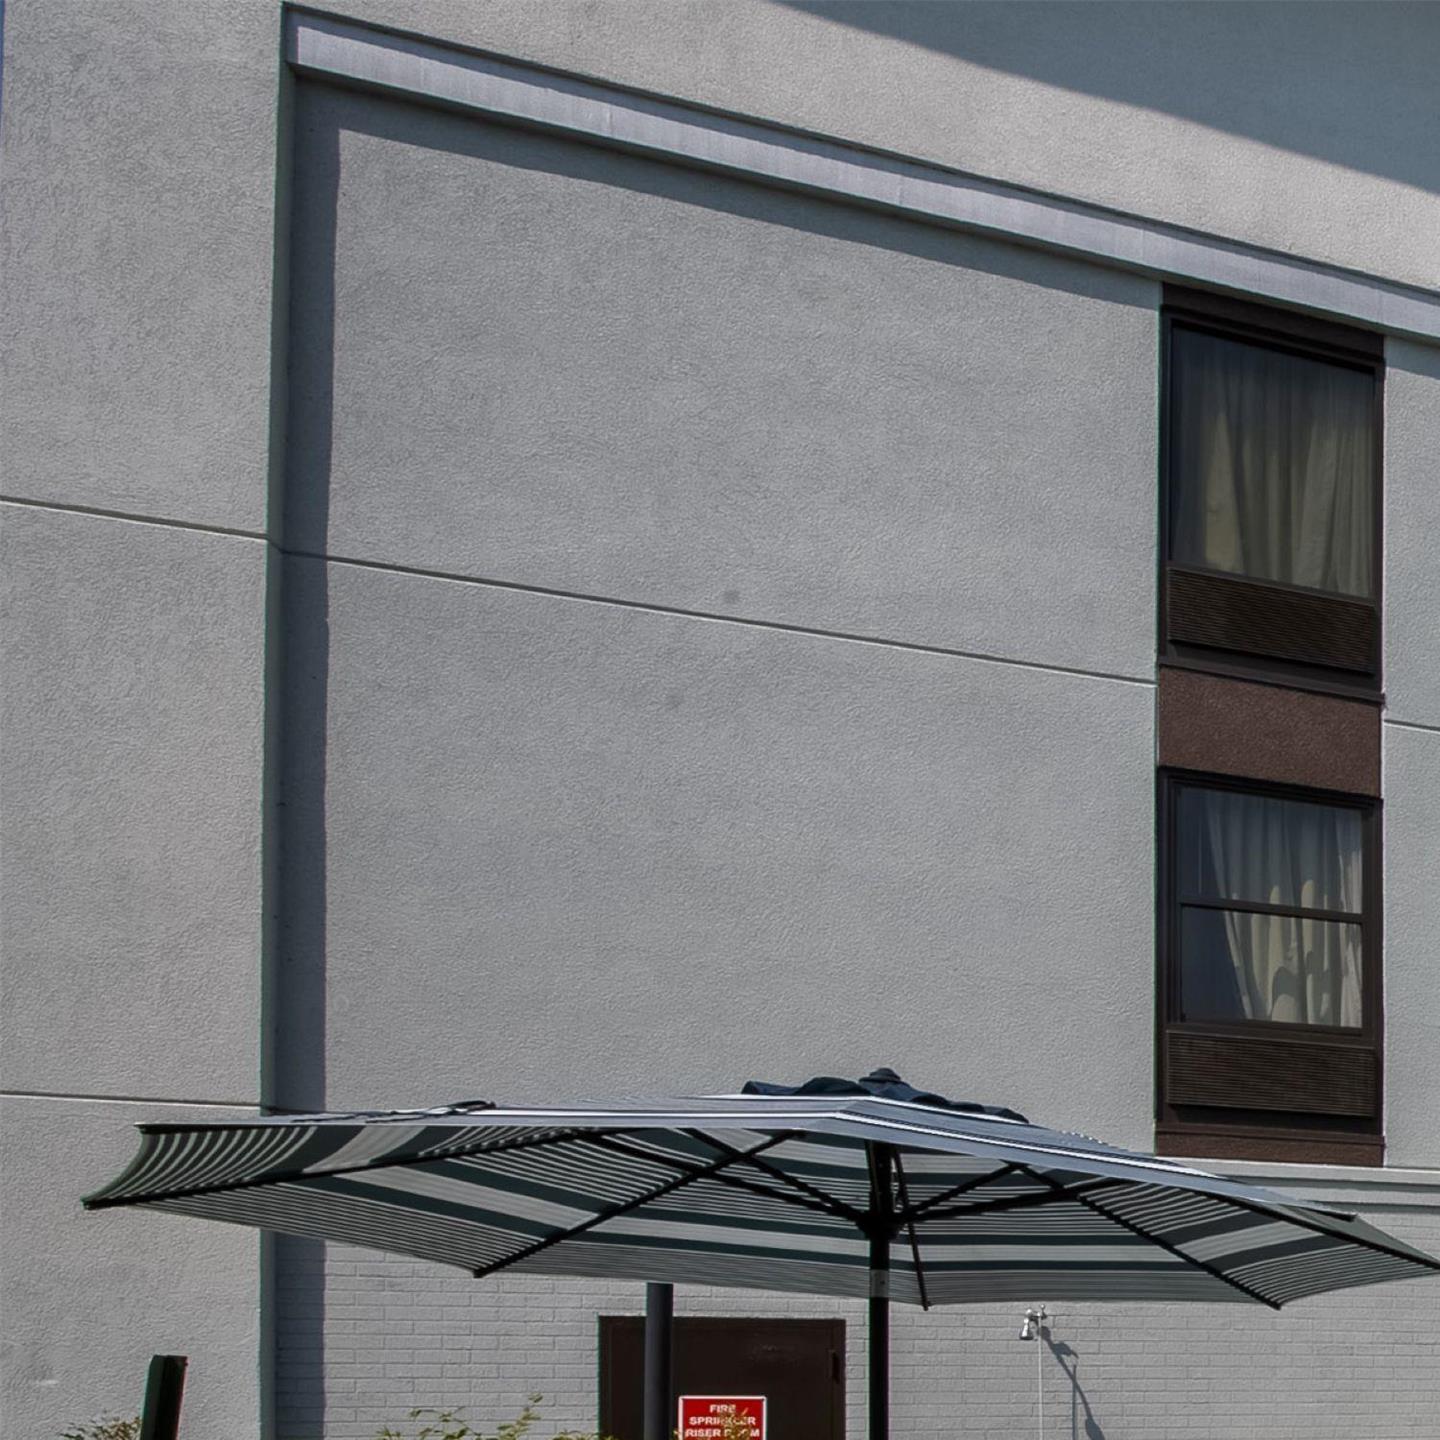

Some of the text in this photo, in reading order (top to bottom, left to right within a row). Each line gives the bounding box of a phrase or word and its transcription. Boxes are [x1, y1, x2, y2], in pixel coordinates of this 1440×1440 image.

[709, 1404, 736, 1413] FIRE
[685, 1428, 760, 1438] RISER RM
